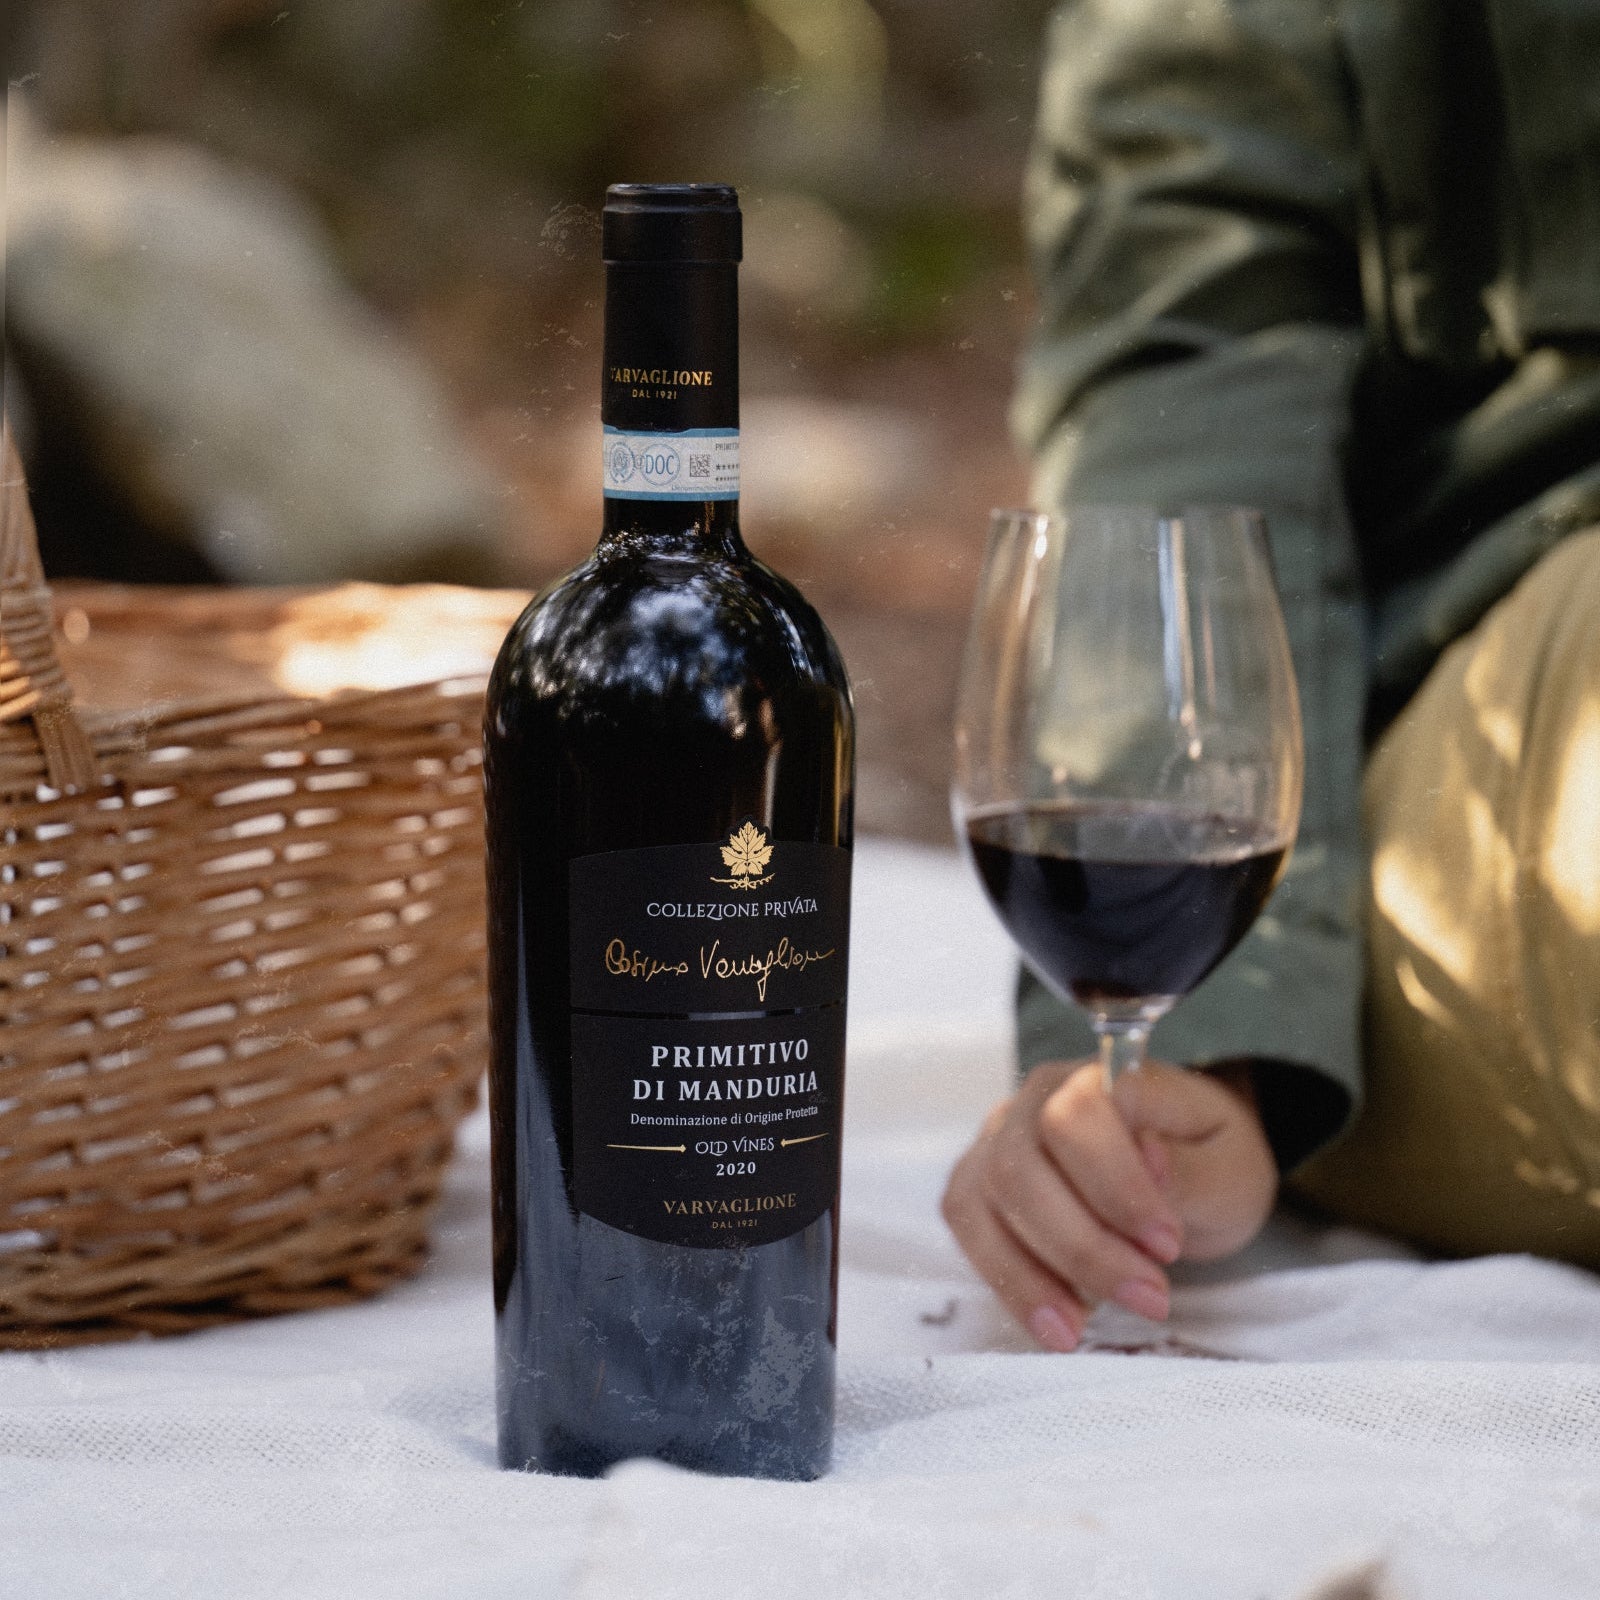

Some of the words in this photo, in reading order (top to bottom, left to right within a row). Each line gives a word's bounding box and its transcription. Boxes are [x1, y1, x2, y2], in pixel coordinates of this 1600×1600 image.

[631, 388, 651, 399] DAL
[655, 389, 677, 400] 1921
[645, 454, 675, 475] DOC
[646, 902, 759, 921] COLLEZIONE
[764, 896, 818, 918] PRIVATA
[651, 1038, 809, 1068] PRIMITIVO
[633, 1079, 665, 1101] DI
[678, 1070, 818, 1101] MANDURIA
[630, 1113, 728, 1127] Denominazione
[730, 1111, 742, 1125] di
[744, 1110, 783, 1126] Origine
[785, 1104, 819, 1121] Protetta
[695, 1140, 728, 1157] OLD
[731, 1135, 775, 1153] VINES
[716, 1161, 757, 1177] 2020
[663, 1192, 798, 1216] VARVAGLIONE
[712, 1219, 734, 1230] DAL
[737, 1218, 759, 1228] 1921
